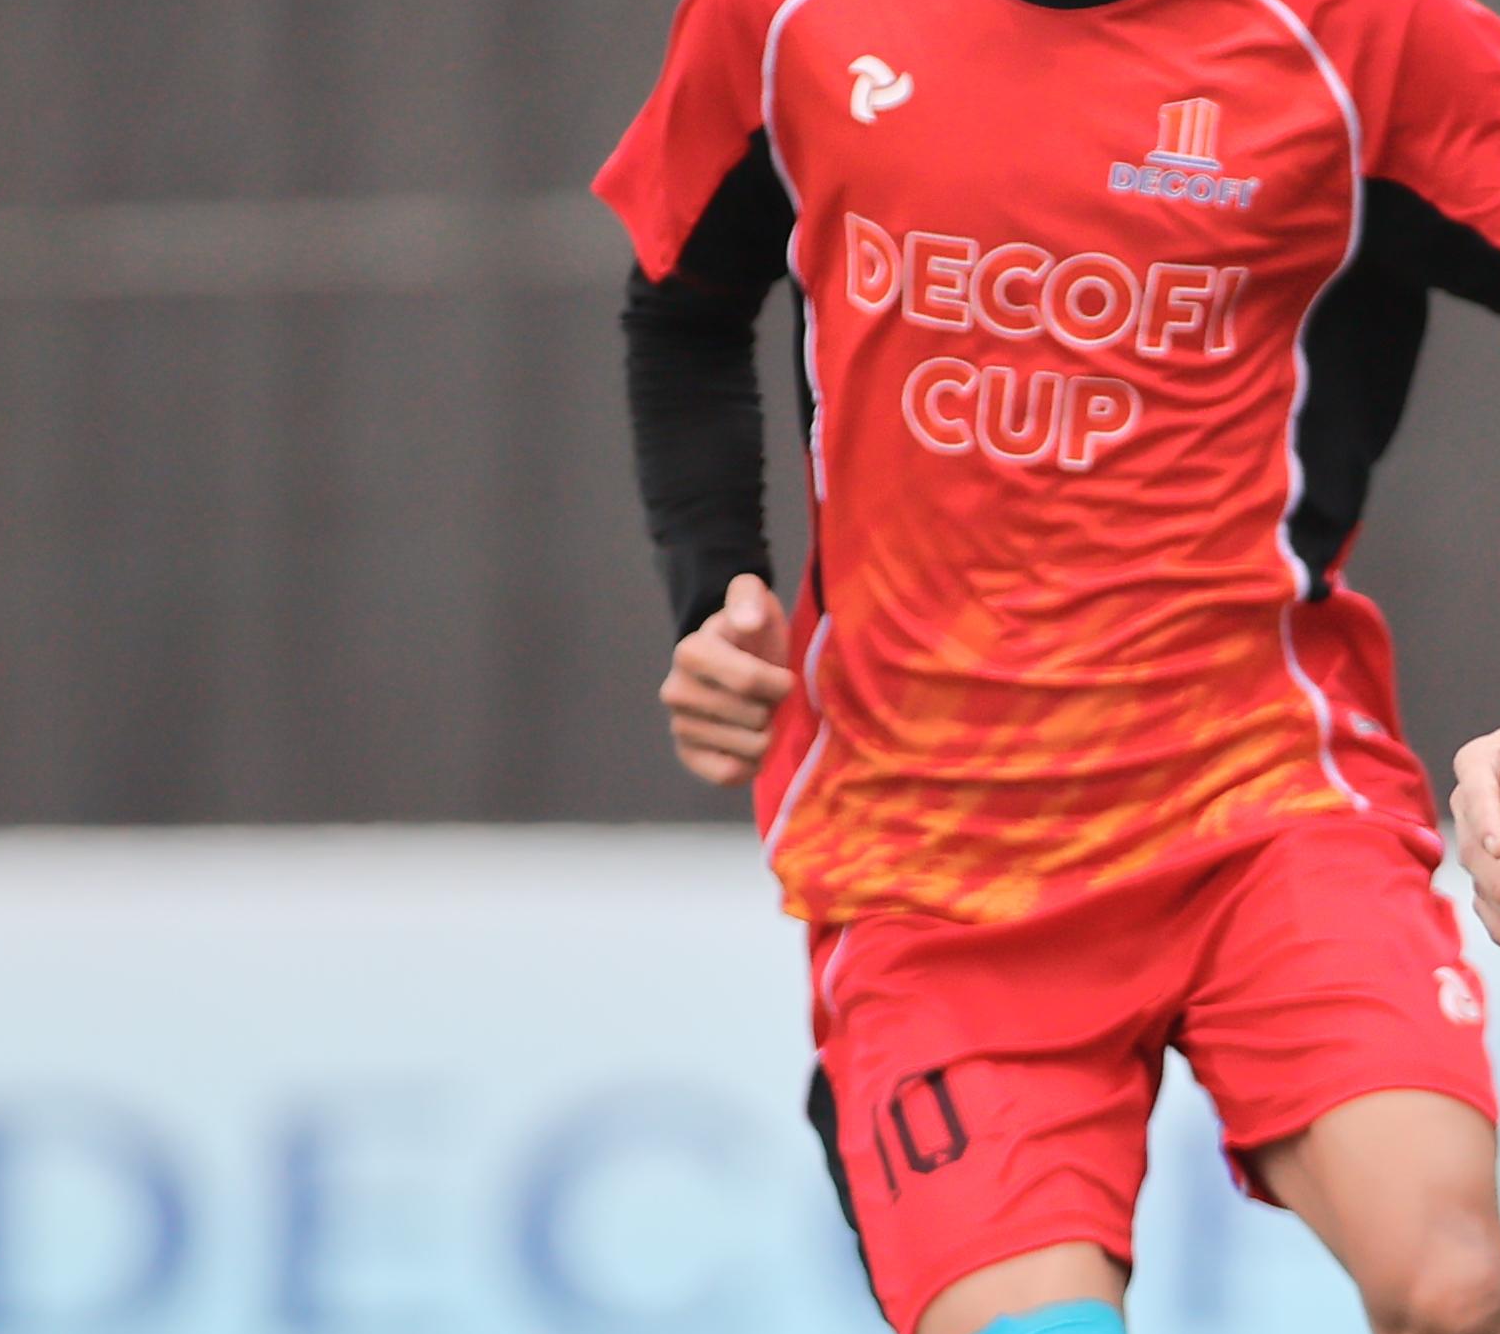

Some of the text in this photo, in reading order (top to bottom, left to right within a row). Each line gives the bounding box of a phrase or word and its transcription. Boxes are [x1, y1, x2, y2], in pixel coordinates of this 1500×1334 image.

[1109, 161, 1256, 209] DECOFI
[843, 210, 1250, 357] DECOFI
[901, 356, 1144, 472] CUP
[872, 1069, 970, 1203] 10
